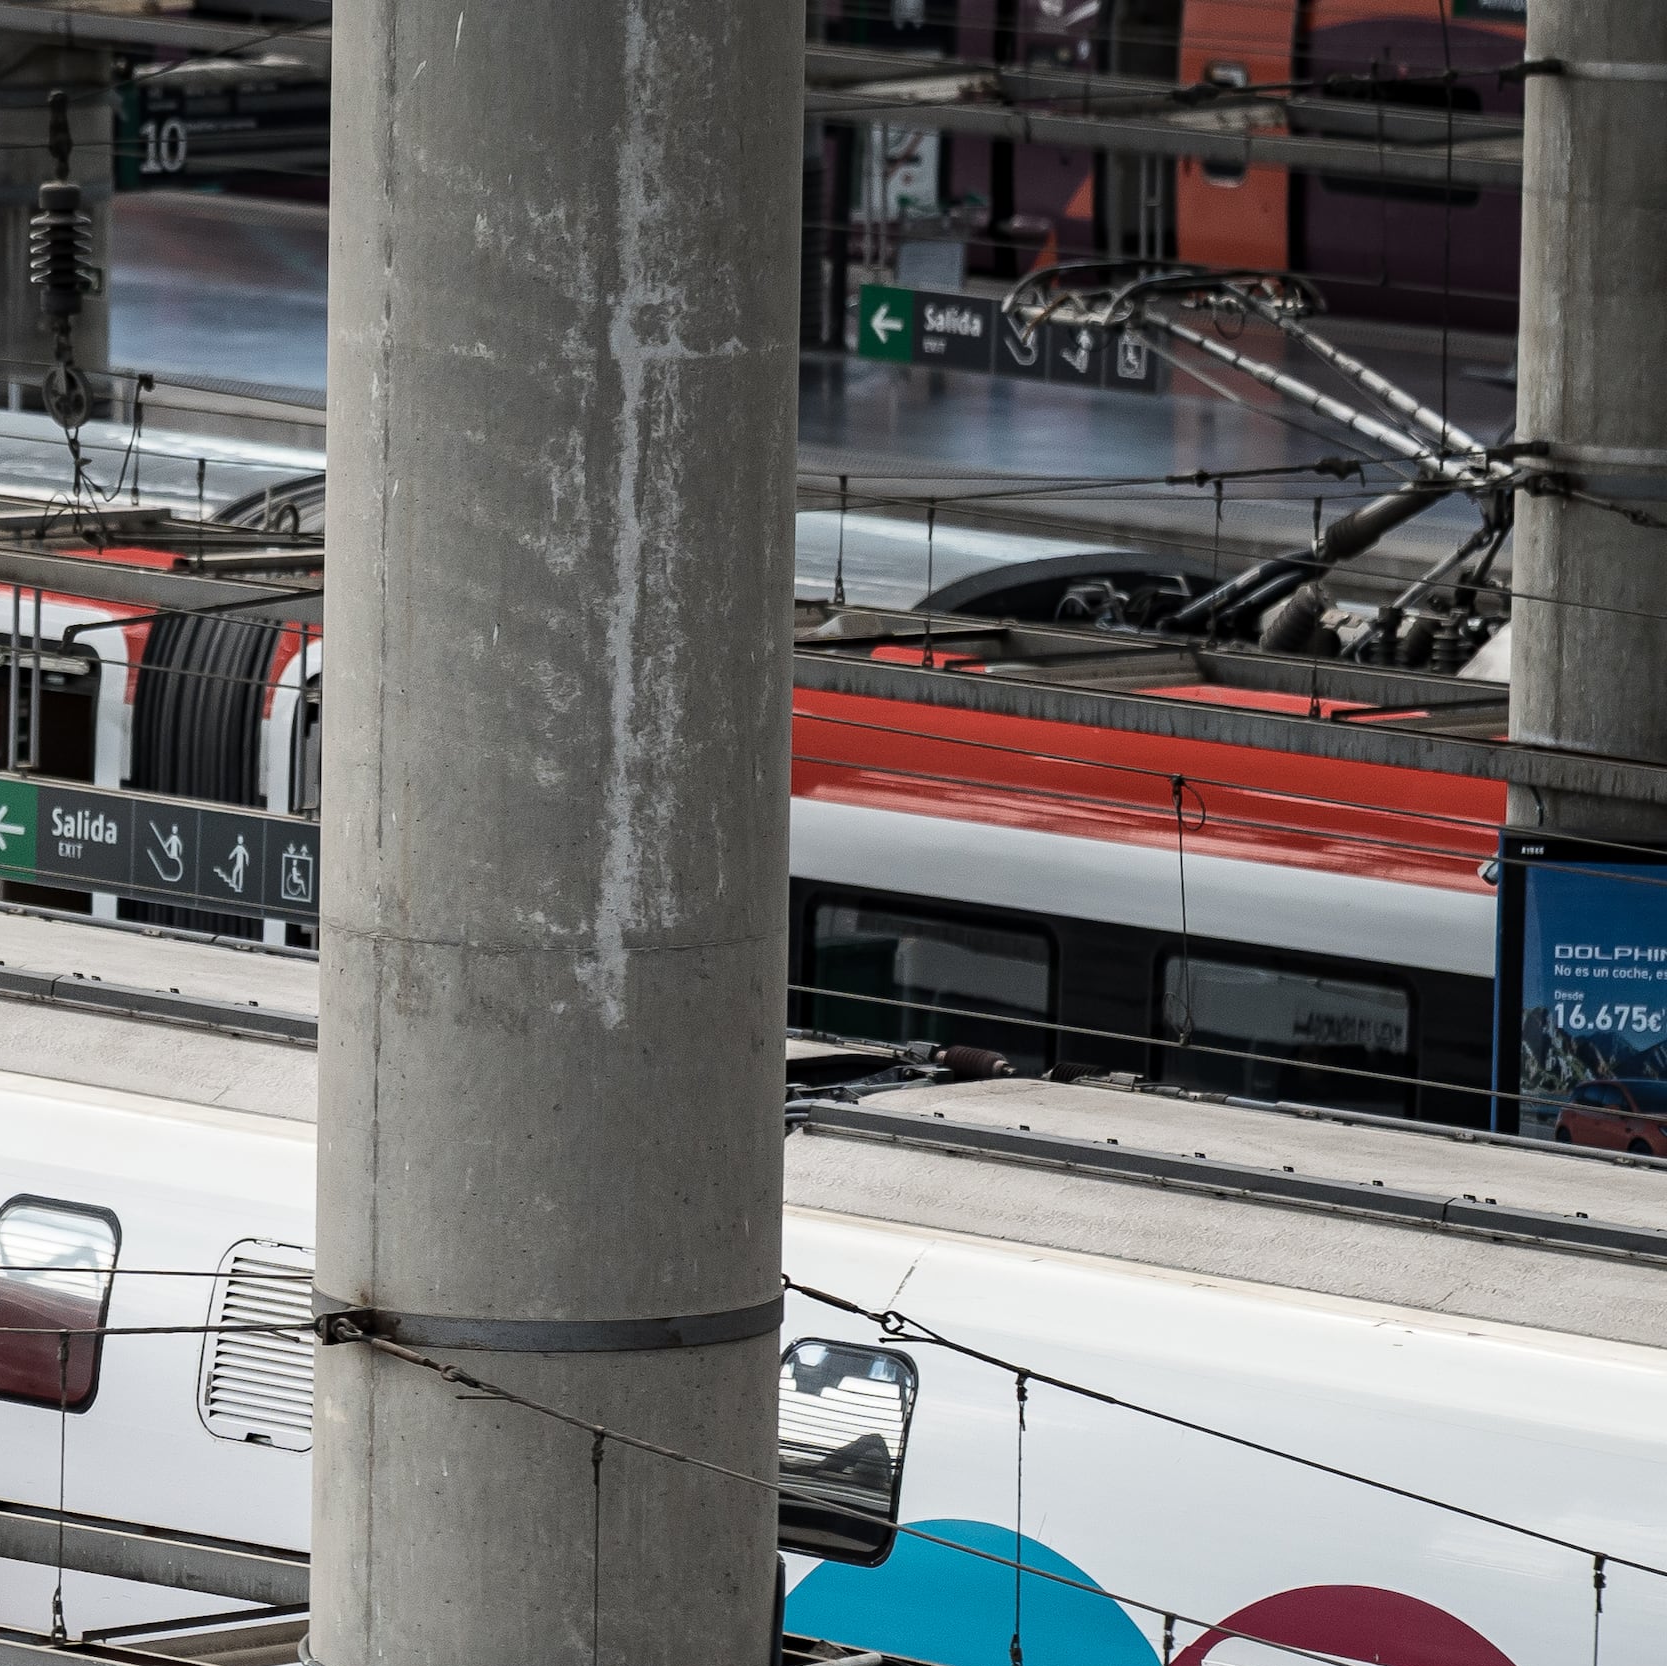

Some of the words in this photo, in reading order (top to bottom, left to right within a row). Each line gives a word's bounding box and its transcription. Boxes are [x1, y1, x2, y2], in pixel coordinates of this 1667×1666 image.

[139, 117, 187, 173] 10
[51, 806, 118, 845] Salida
[58, 842, 83, 859] EXIT
[1554, 965, 1571, 976] No
[1575, 967, 1589, 977] es
[1593, 968, 1609, 978] un
[1612, 966, 1652, 981] coche,
[1554, 990, 1585, 1001] Desde
